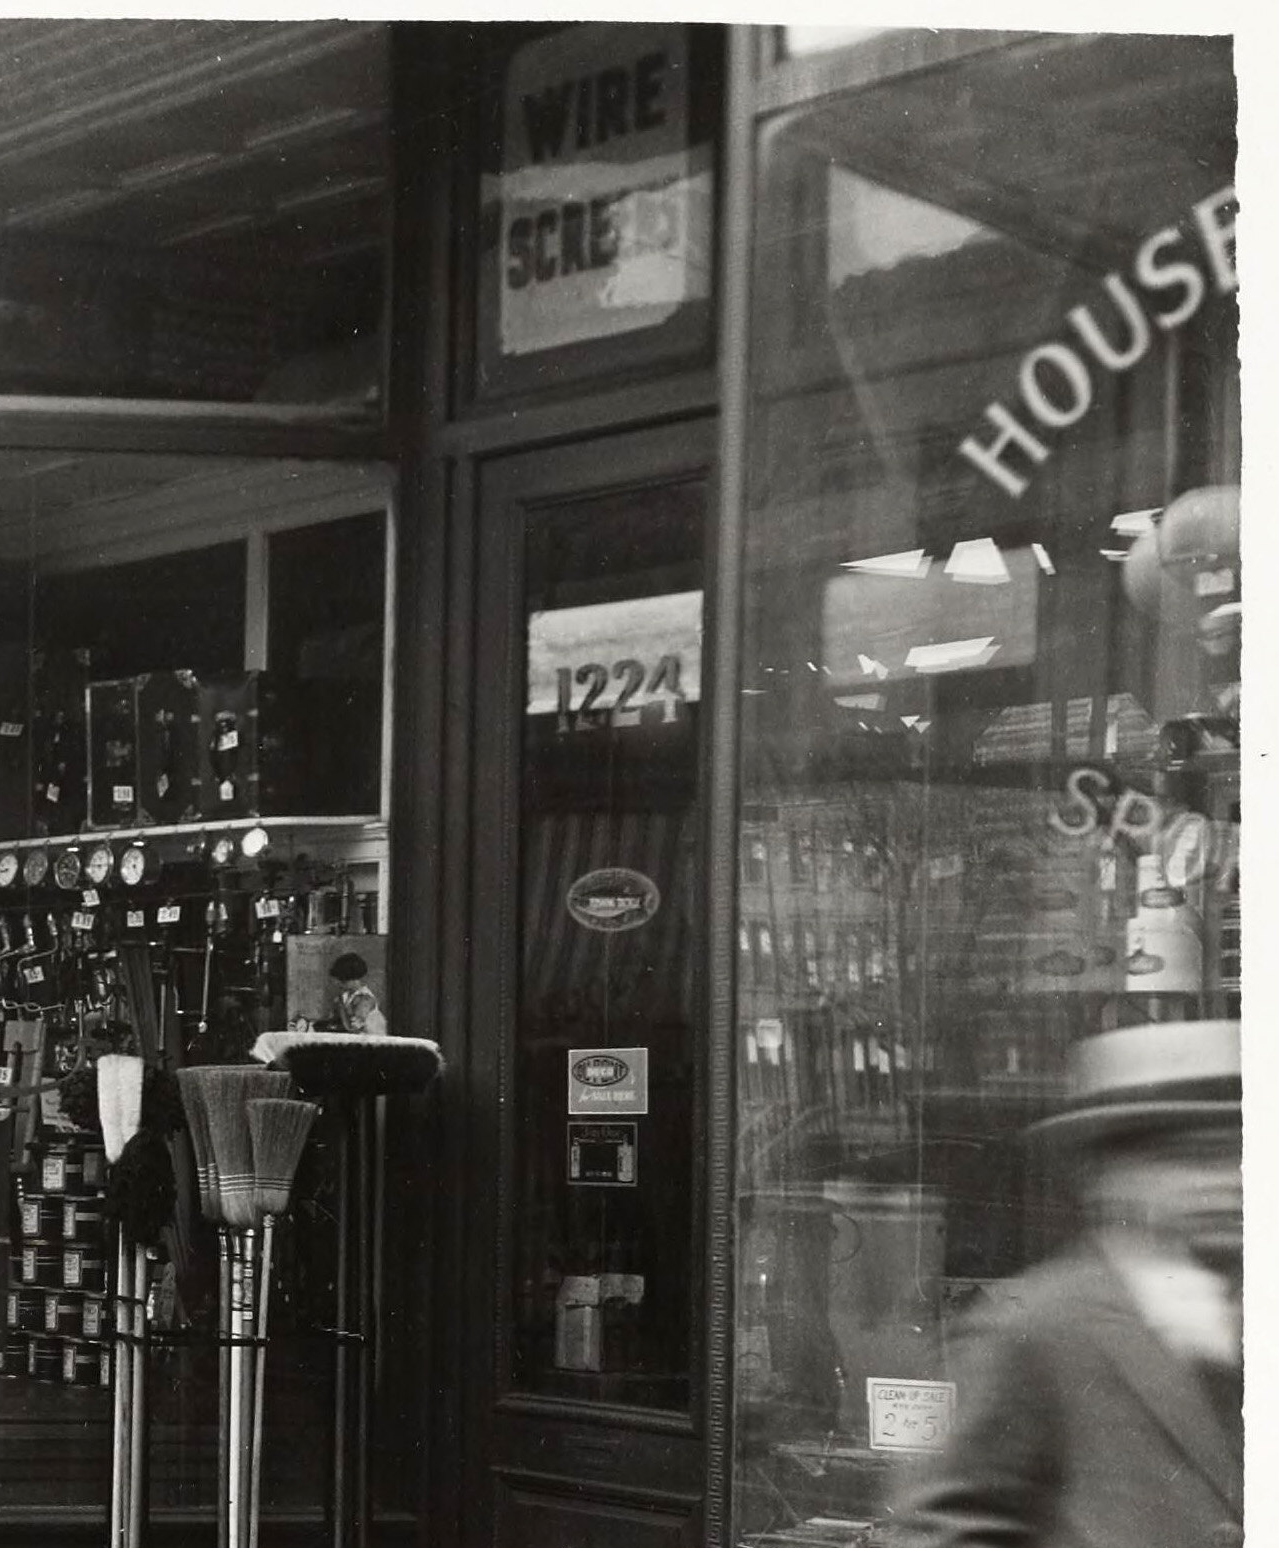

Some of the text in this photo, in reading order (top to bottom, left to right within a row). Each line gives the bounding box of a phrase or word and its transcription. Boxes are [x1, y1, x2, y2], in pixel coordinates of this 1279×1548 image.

[523, 51, 667, 165] WIRE
[556, 655, 685, 733] 1224
[882, 1412, 896, 1437] 2
